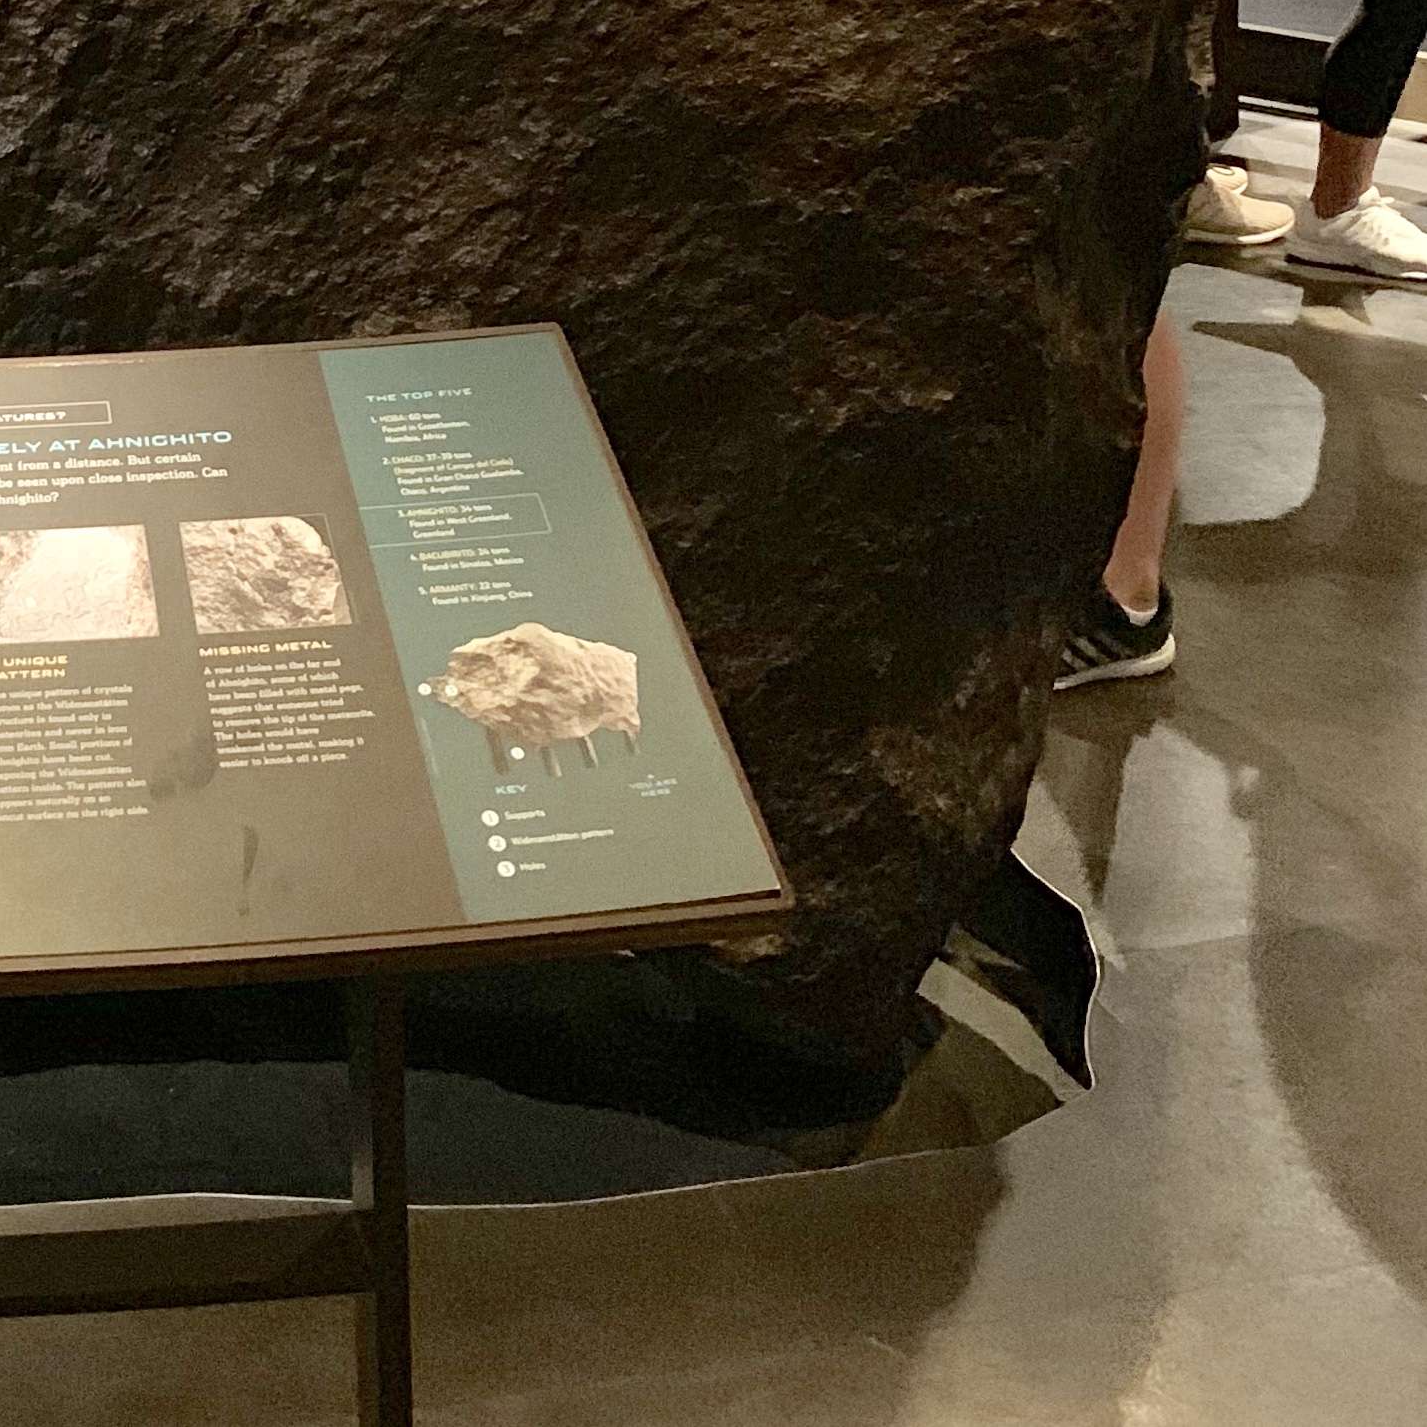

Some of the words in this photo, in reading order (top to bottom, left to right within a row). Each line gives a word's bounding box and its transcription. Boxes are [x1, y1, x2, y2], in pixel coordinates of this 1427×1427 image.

[366, 394, 396, 402] THE
[401, 391, 432, 399] TOP
[438, 388, 471, 396] FIVE
[49, 439, 80, 451] AT
[88, 431, 231, 449] AHNIGHITO
[17, 460, 49, 470] from
[53, 461, 61, 469] a
[64, 457, 123, 468] distance.
[127, 455, 151, 465] But
[154, 452, 201, 464] certain
[17, 478, 48, 487] seen
[51, 477, 84, 487] upon
[88, 472, 122, 483] close
[126, 469, 198, 483] inspection.
[201, 467, 228, 477] Can
[199, 644, 270, 656] MISSING
[275, 641, 332, 651] METAL
[3, 655, 67, 666] UNIQUE
[495, 785, 526, 794] KEY
